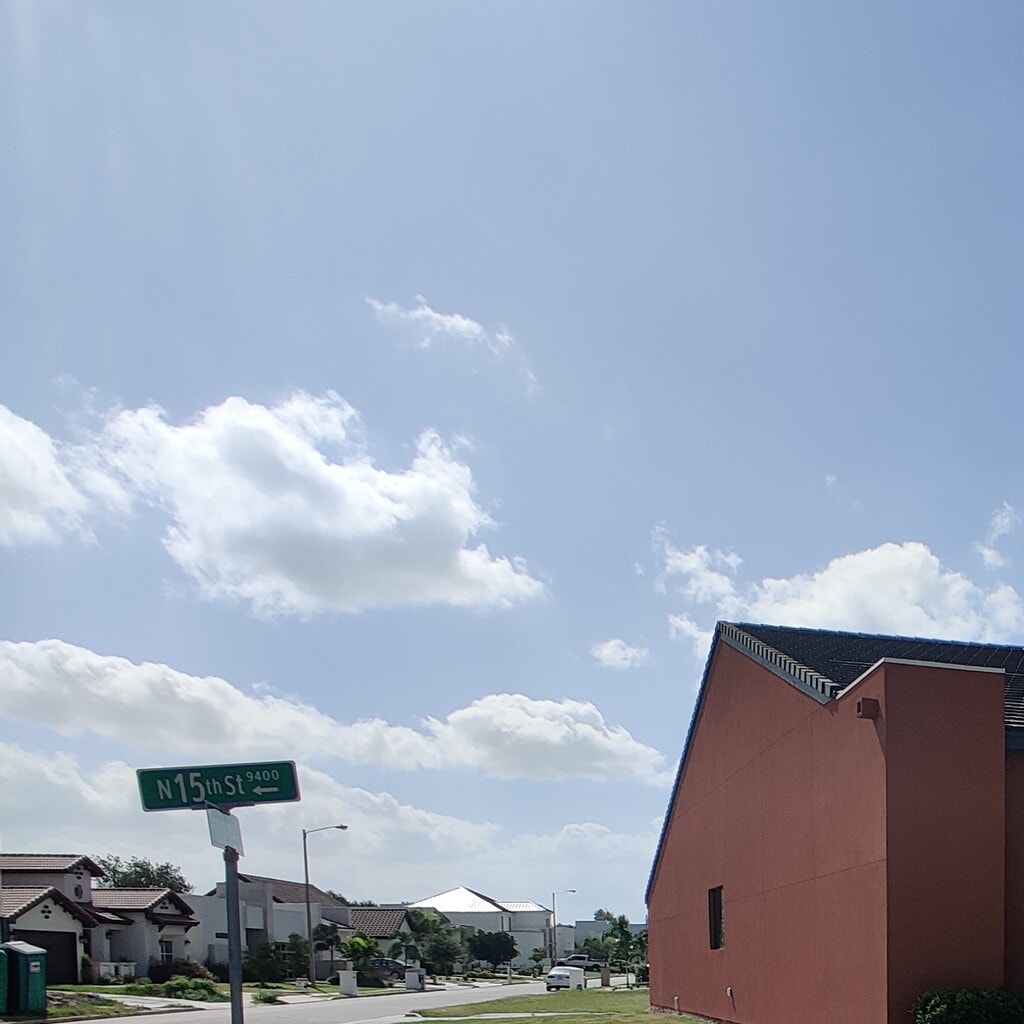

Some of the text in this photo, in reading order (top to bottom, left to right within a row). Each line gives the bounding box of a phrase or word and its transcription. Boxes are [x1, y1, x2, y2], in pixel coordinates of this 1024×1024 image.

[157, 769, 280, 803] N 15th St 9400
